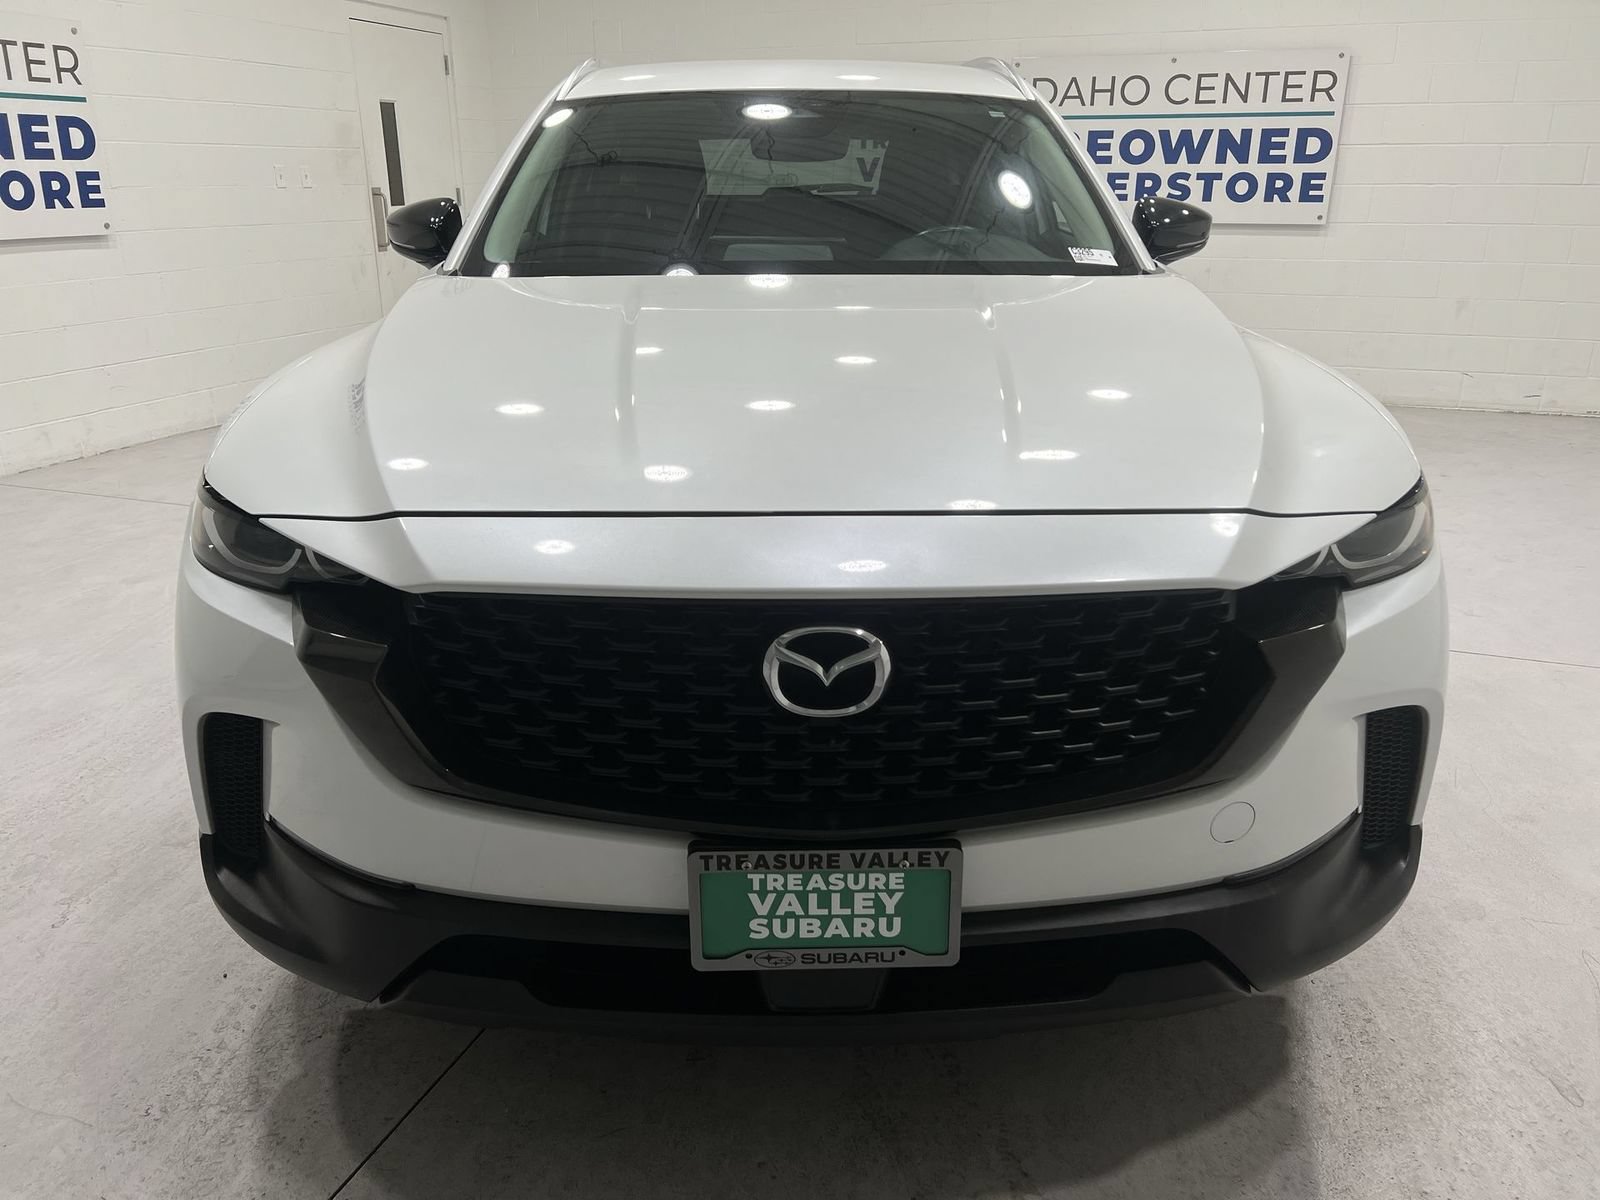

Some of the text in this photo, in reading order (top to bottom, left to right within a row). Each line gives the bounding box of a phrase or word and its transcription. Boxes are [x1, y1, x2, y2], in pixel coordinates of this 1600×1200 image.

[0, 38, 82, 85] TER
[1024, 70, 1338, 107] DAHO CENTER
[1073, 127, 1333, 165] EOWNED
[0, 170, 106, 211] ORE
[1107, 172, 1327, 203] ERSTORE
[700, 851, 950, 871] TREASURE VALLEY
[747, 872, 905, 891] TREASURE
[747, 892, 904, 916] VALLEY
[749, 917, 902, 939] SUBARU
[801, 951, 896, 965] SUBARU
